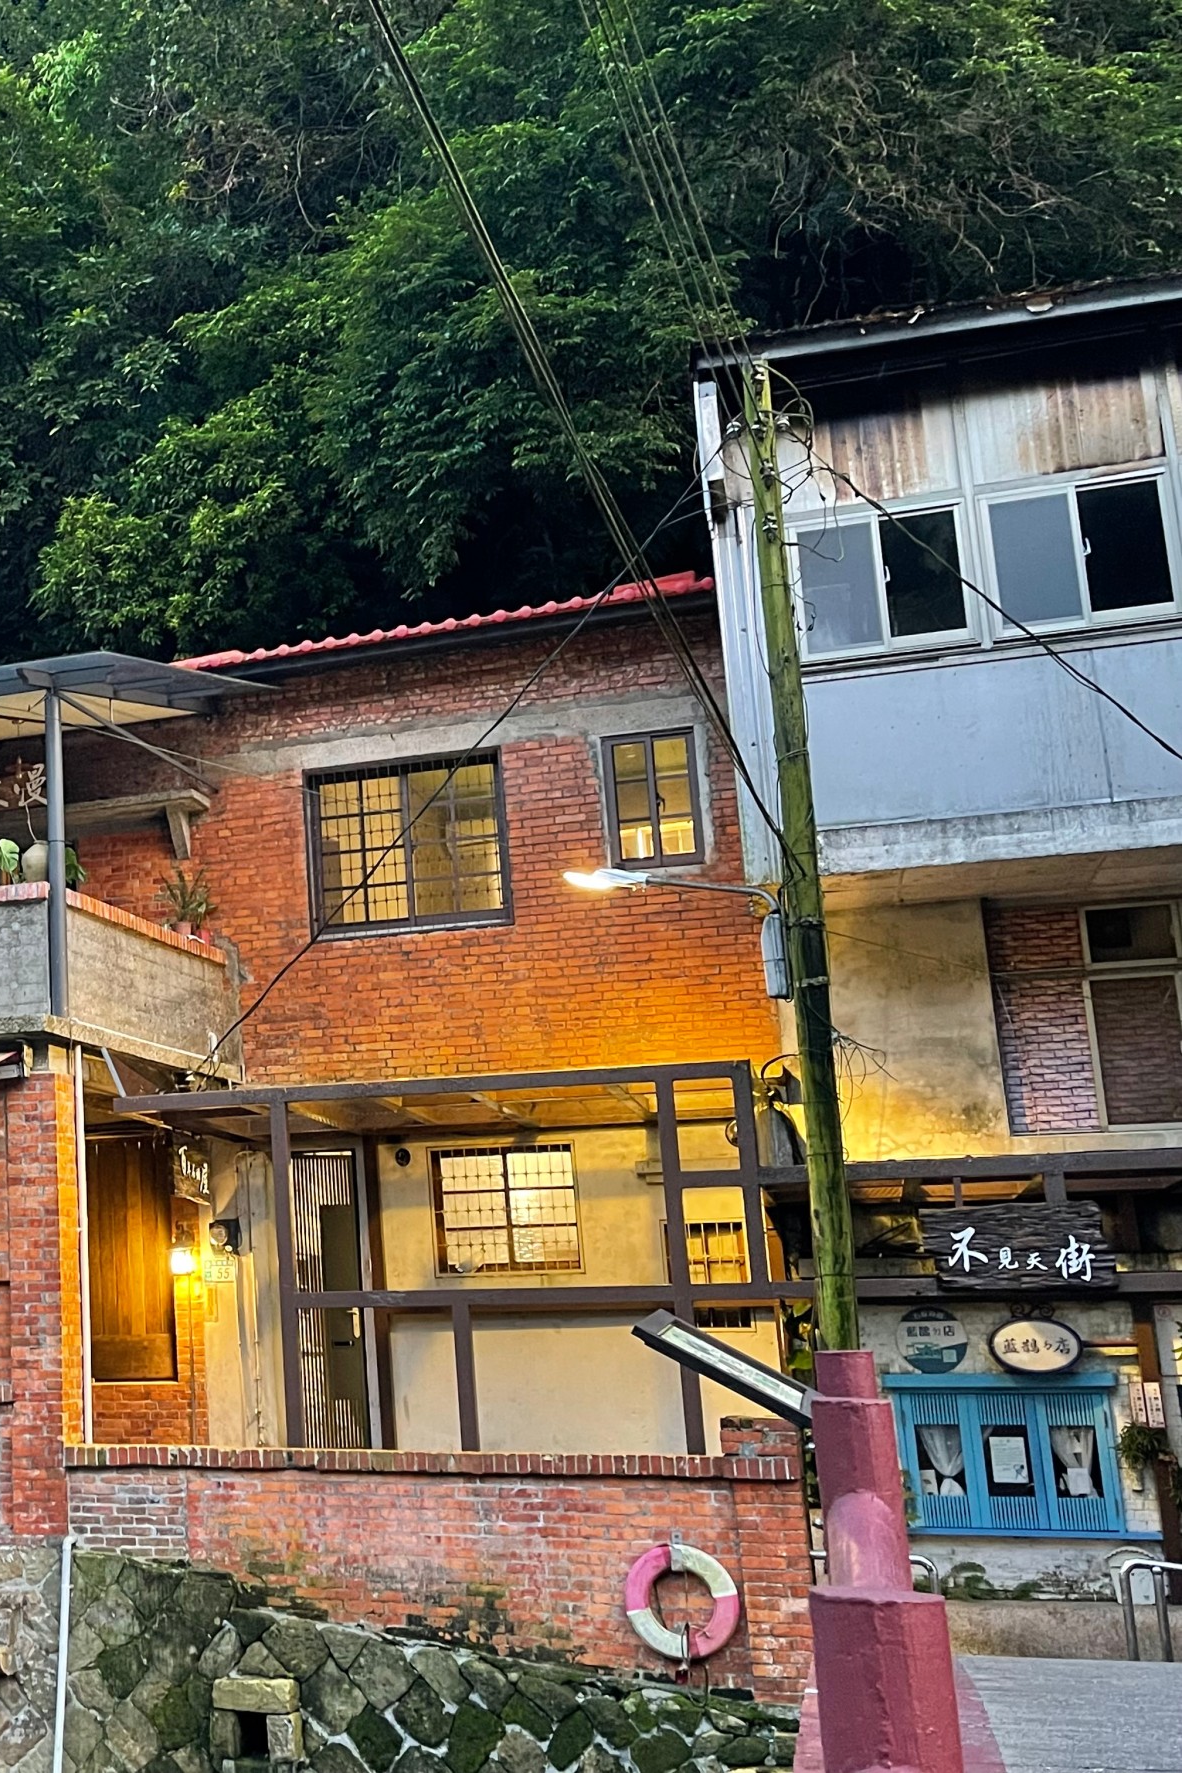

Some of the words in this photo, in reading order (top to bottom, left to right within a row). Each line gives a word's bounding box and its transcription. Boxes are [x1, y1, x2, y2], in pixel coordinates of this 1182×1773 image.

[947, 1226, 1096, 1282] 不見天街
[216, 1267, 231, 1280] 55
